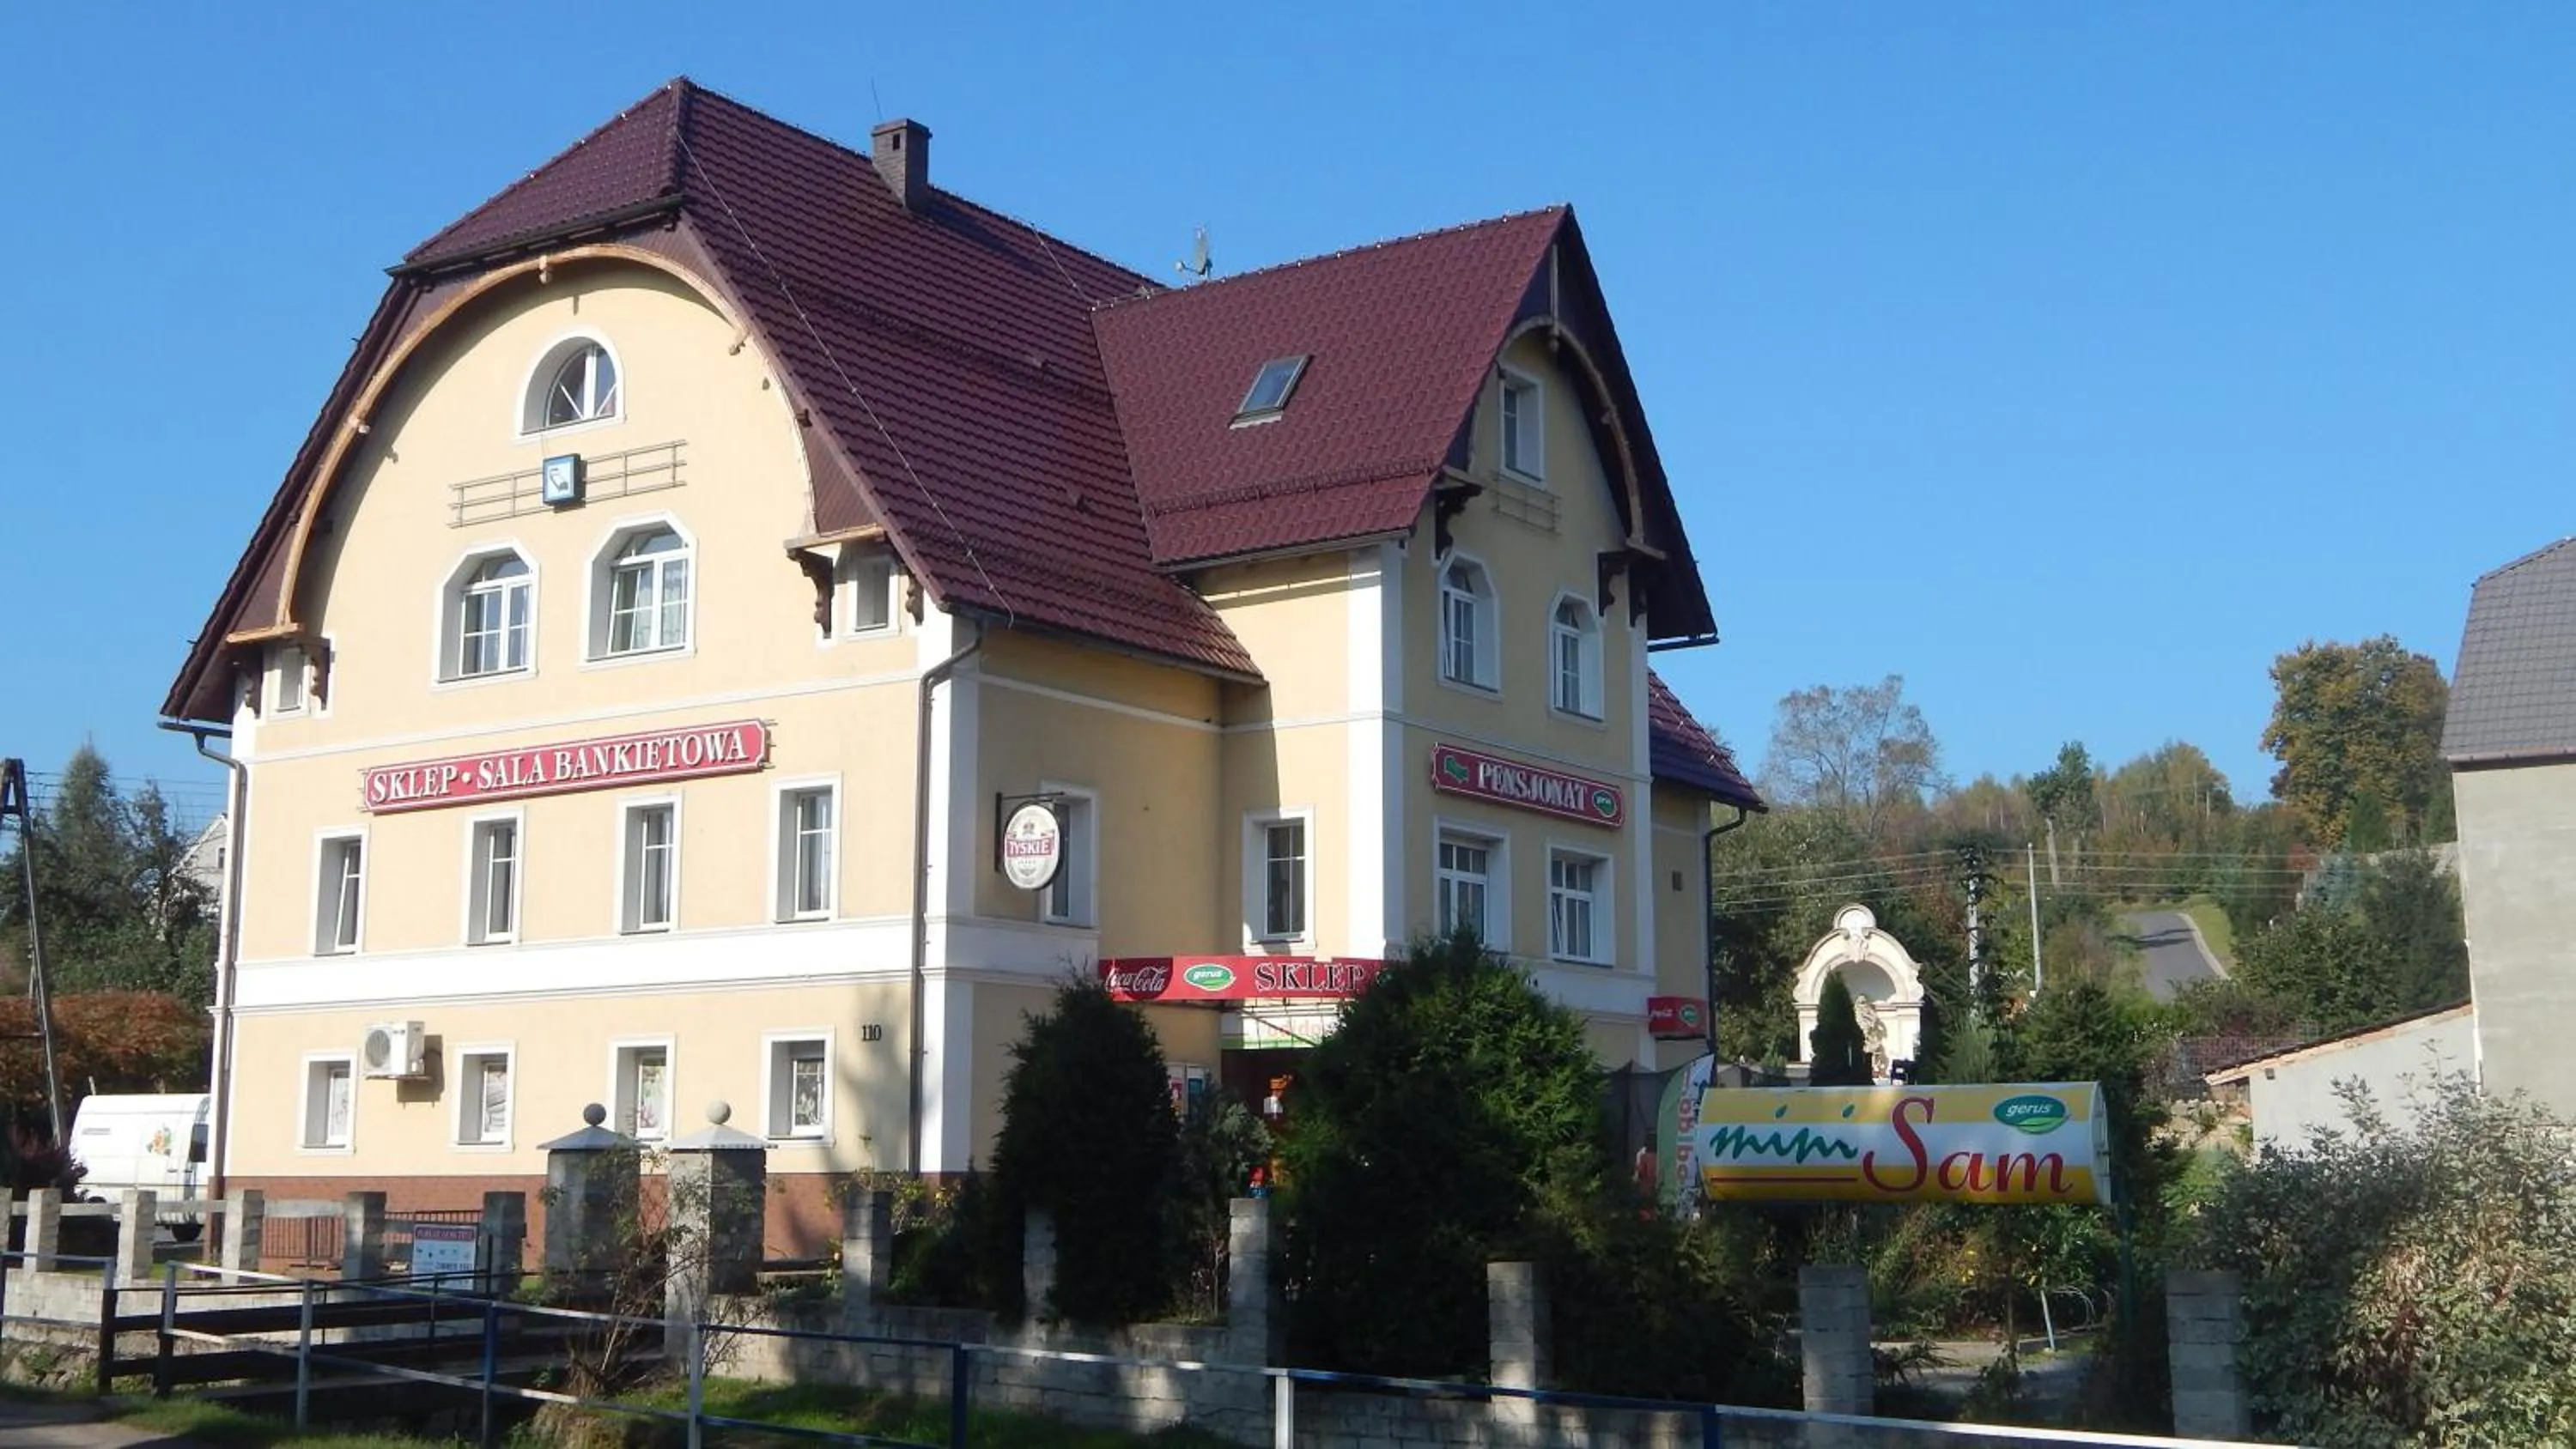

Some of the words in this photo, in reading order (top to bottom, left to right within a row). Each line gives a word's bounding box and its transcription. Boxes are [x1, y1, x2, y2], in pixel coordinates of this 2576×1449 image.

[371, 764, 460, 803] SKLEP
[476, 757, 547, 790] SALA
[553, 728, 749, 782] BANKIETOWA
[1478, 762, 1587, 810] PENSJONAT
[1008, 840, 1049, 855] TYSKIE
[1255, 962, 1364, 992] SKLEP
[2006, 1103, 2052, 1117] gerus
[1710, 1104, 1858, 1164] mini
[1862, 1096, 2074, 1193] Sam
